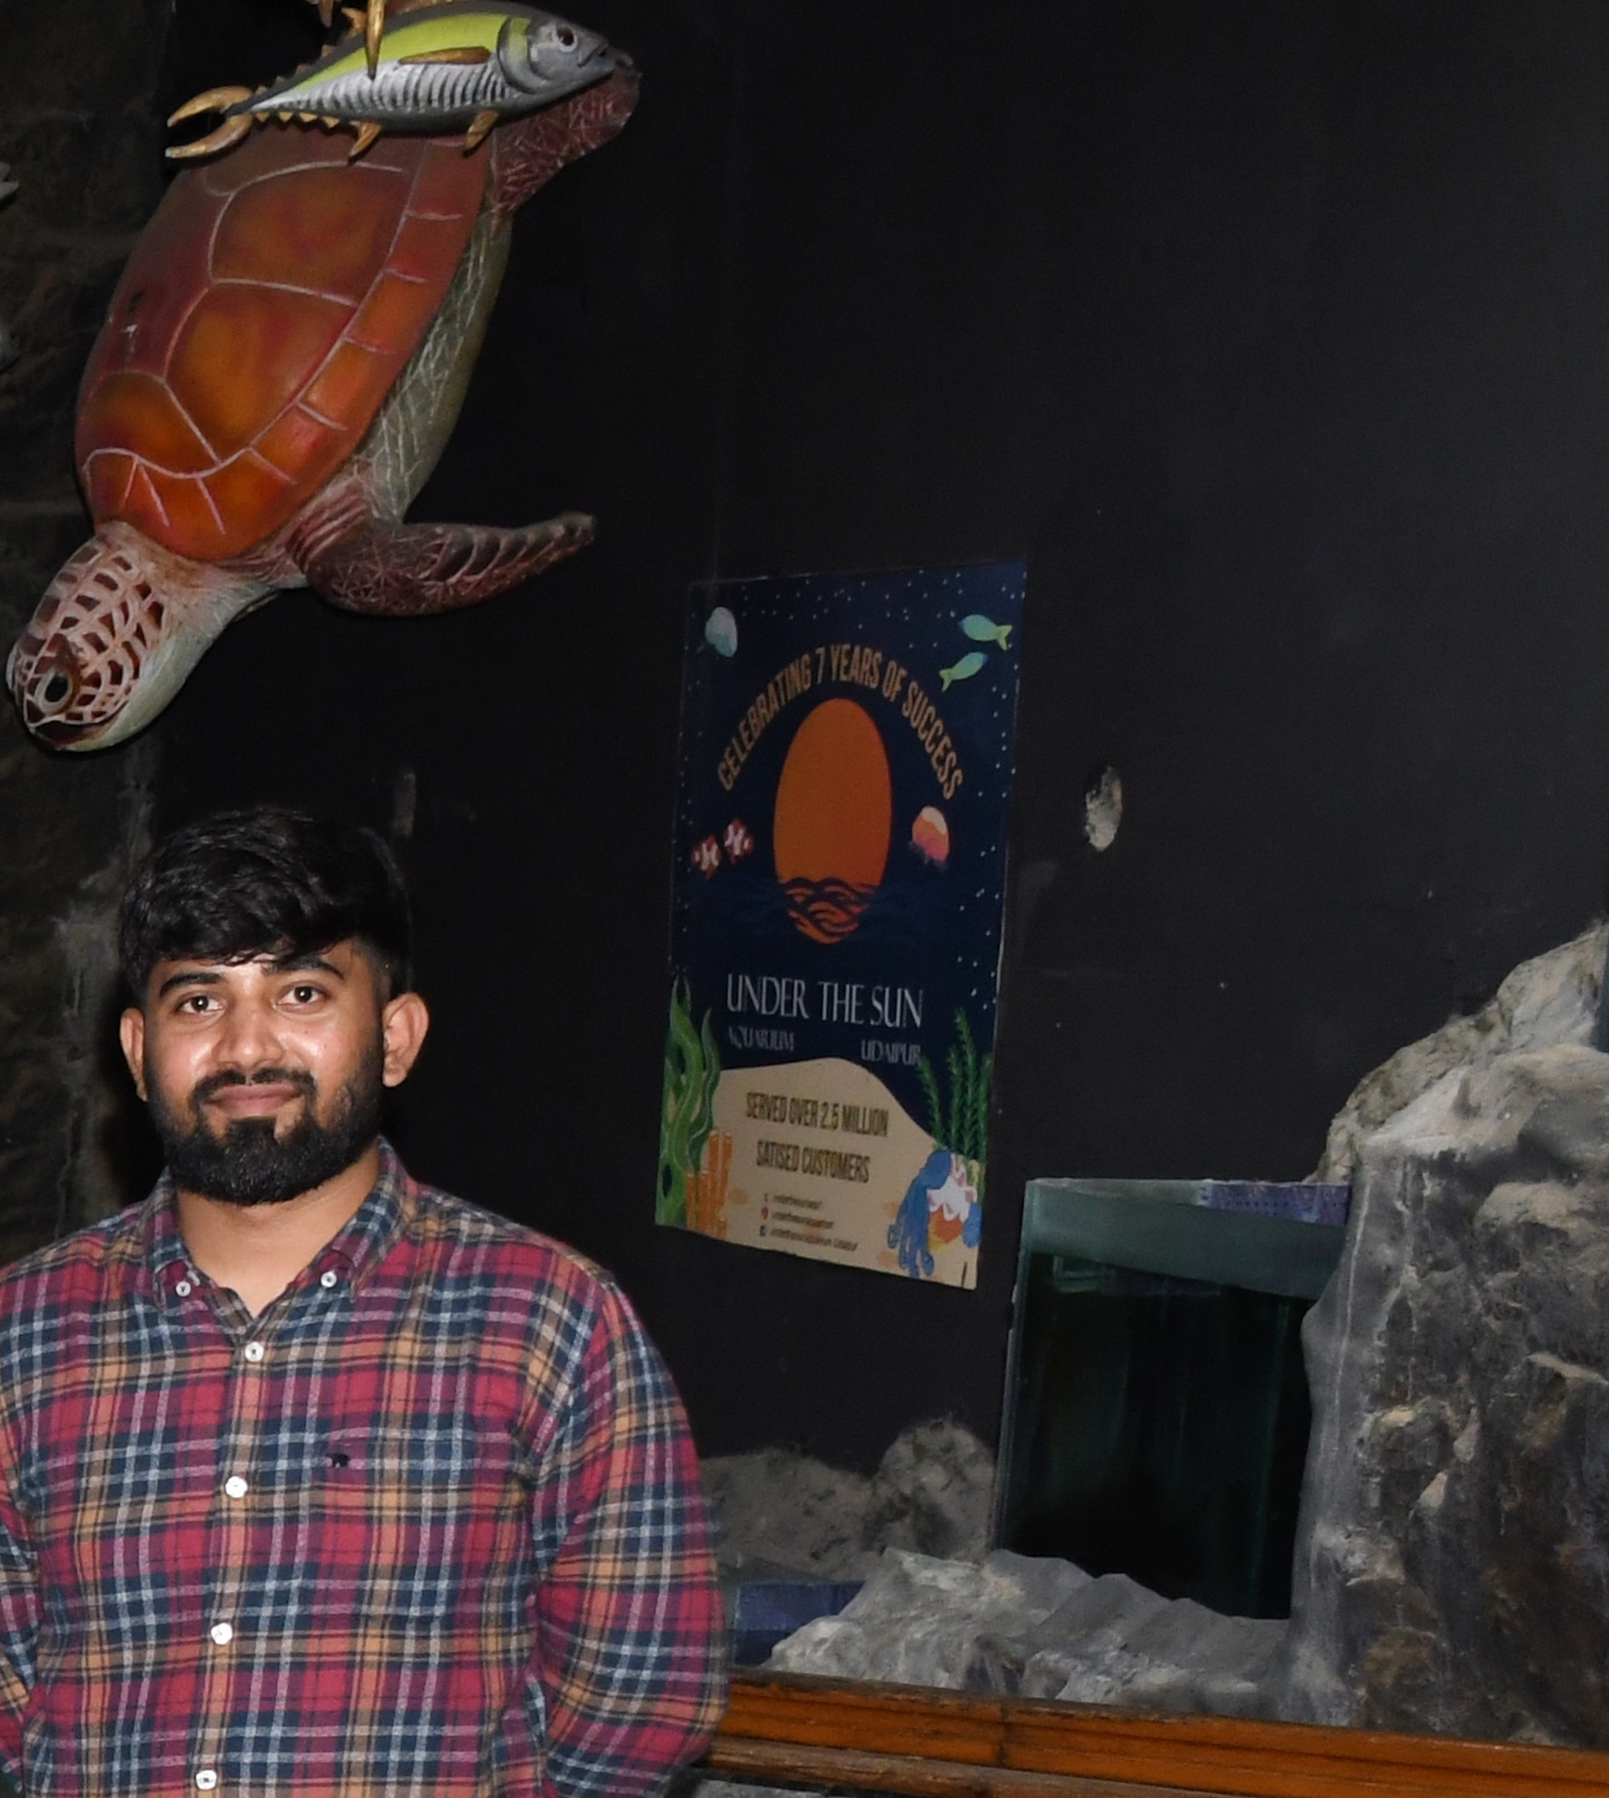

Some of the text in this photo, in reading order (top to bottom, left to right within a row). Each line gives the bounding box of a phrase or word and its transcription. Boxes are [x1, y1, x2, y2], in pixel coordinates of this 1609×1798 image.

[717, 643, 963, 800] CELEBRATING 7 YEARS OF SUCCESS
[727, 973, 924, 1029] UNDER THE SUN
[745, 1091, 788, 1124] SERVED
[788, 1097, 819, 1128] OVER
[841, 1104, 889, 1138] MILLION
[801, 1147, 871, 1184] CUSTOMERS
